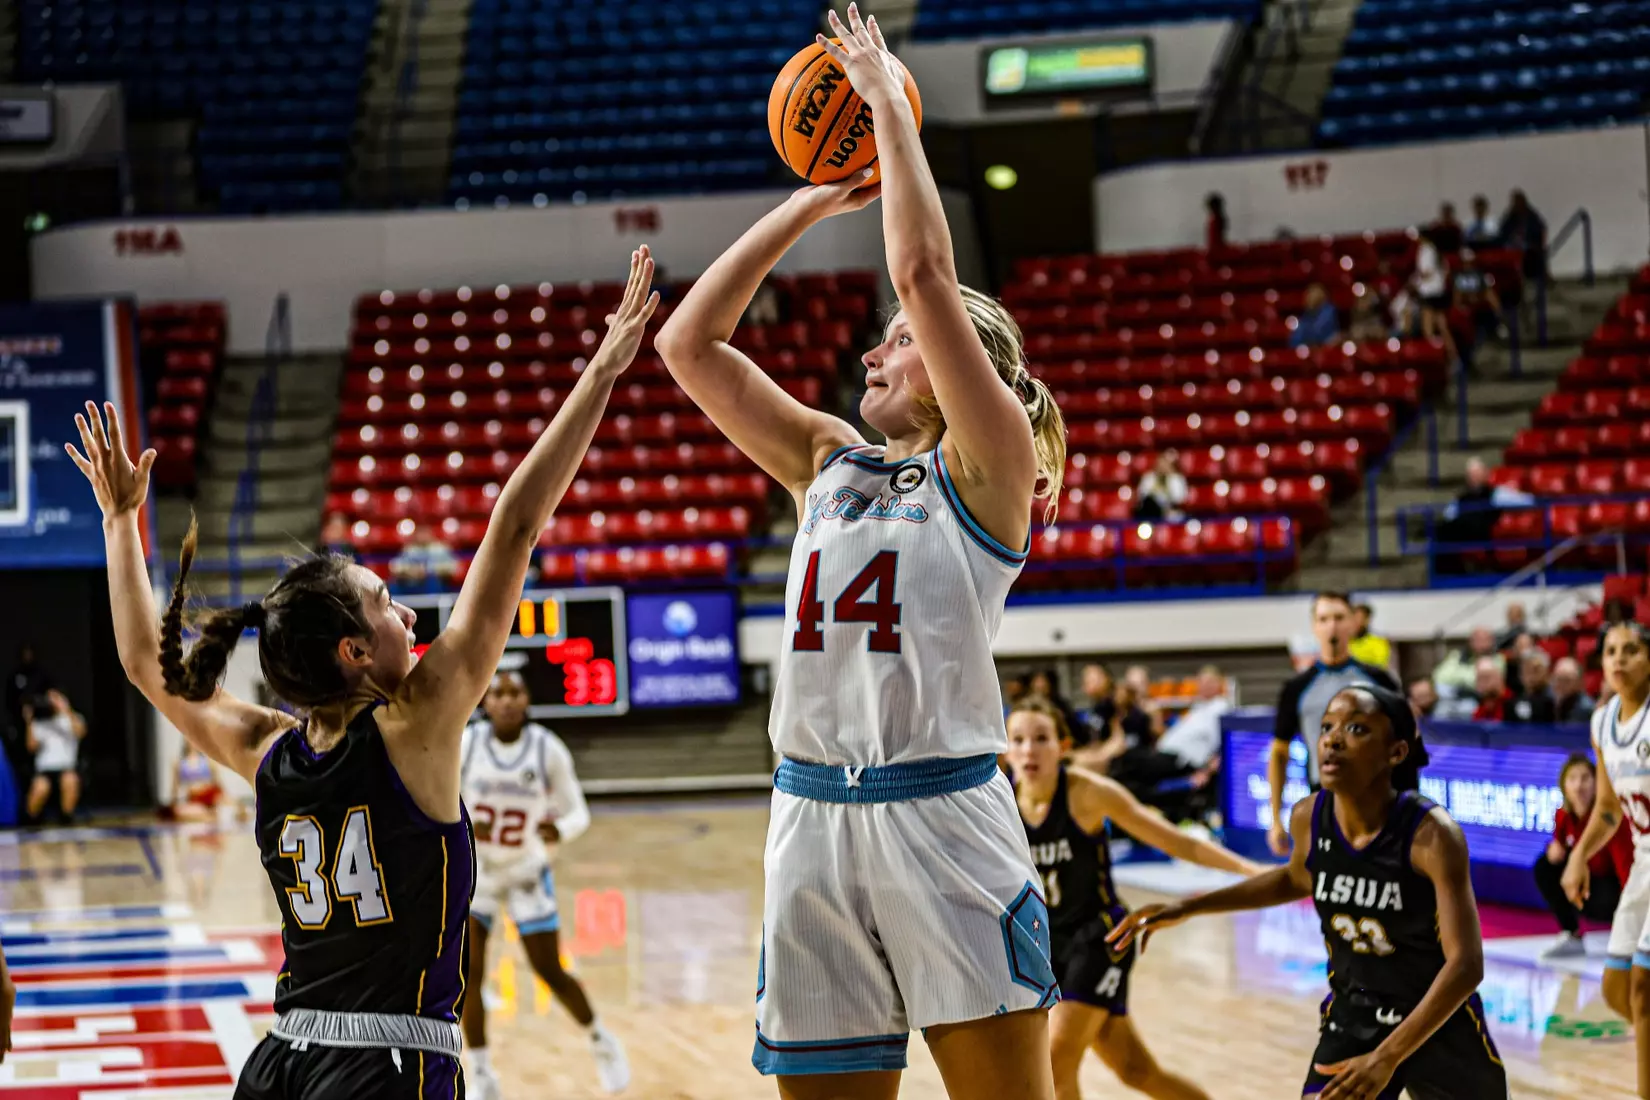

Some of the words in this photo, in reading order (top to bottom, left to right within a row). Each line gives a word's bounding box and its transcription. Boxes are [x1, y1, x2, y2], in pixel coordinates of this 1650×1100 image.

[793, 62, 846, 139] NCAA
[792, 548, 902, 654] 44
[278, 804, 394, 931] 34
[1315, 871, 1403, 911] LSUA
